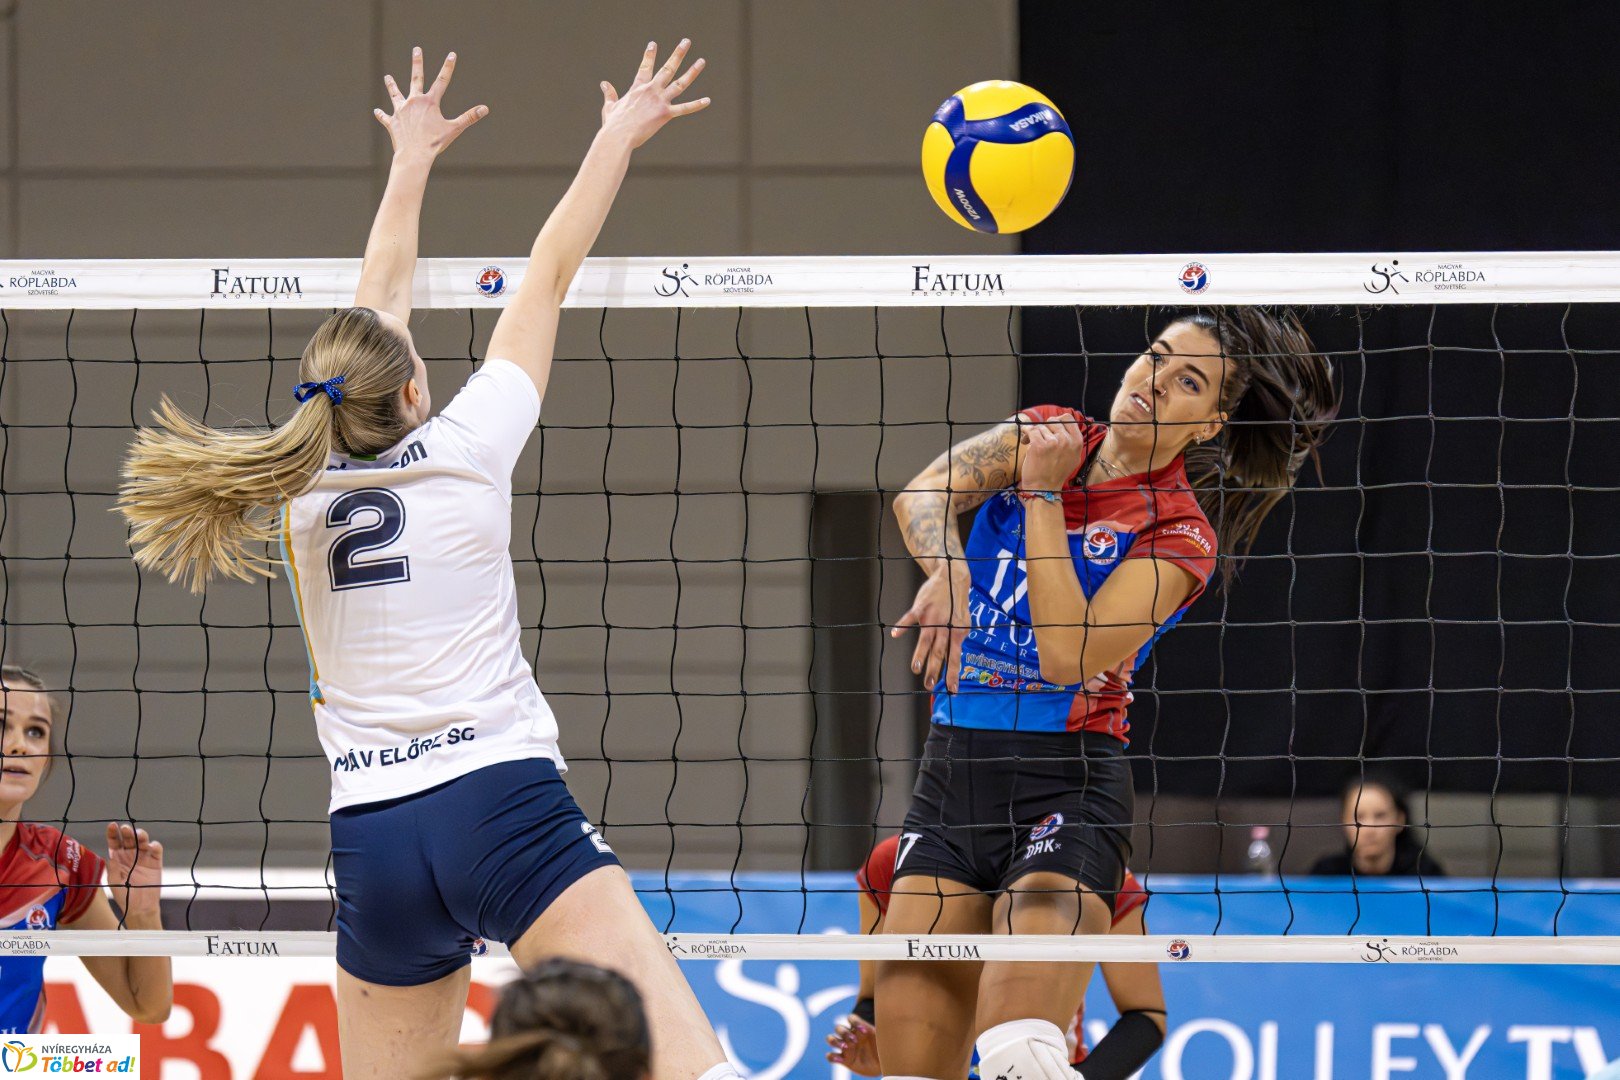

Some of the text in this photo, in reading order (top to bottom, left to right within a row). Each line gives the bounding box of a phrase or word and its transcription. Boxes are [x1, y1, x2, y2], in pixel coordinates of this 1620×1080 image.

[1009, 109, 1050, 132] MIKASA
[954, 187, 981, 220] V200W
[9, 276, 77, 288] RÖPLABDA
[210, 266, 303, 294] FATUM
[704, 273, 773, 286] RÖPLABDA
[911, 264, 1005, 292] FATUM
[1415, 270, 1486, 283] RÖPLABDA
[326, 487, 411, 592] 2
[969, 587, 1038, 652] ATU
[333, 749, 374, 772] MÁV
[0, 939, 51, 950] ÖPLABDA
[204, 934, 280, 956] FATUM
[691, 944, 747, 954] RÖPLABDA
[905, 938, 981, 959] FATUM
[1401, 945, 1458, 956] RÖPLABDA
